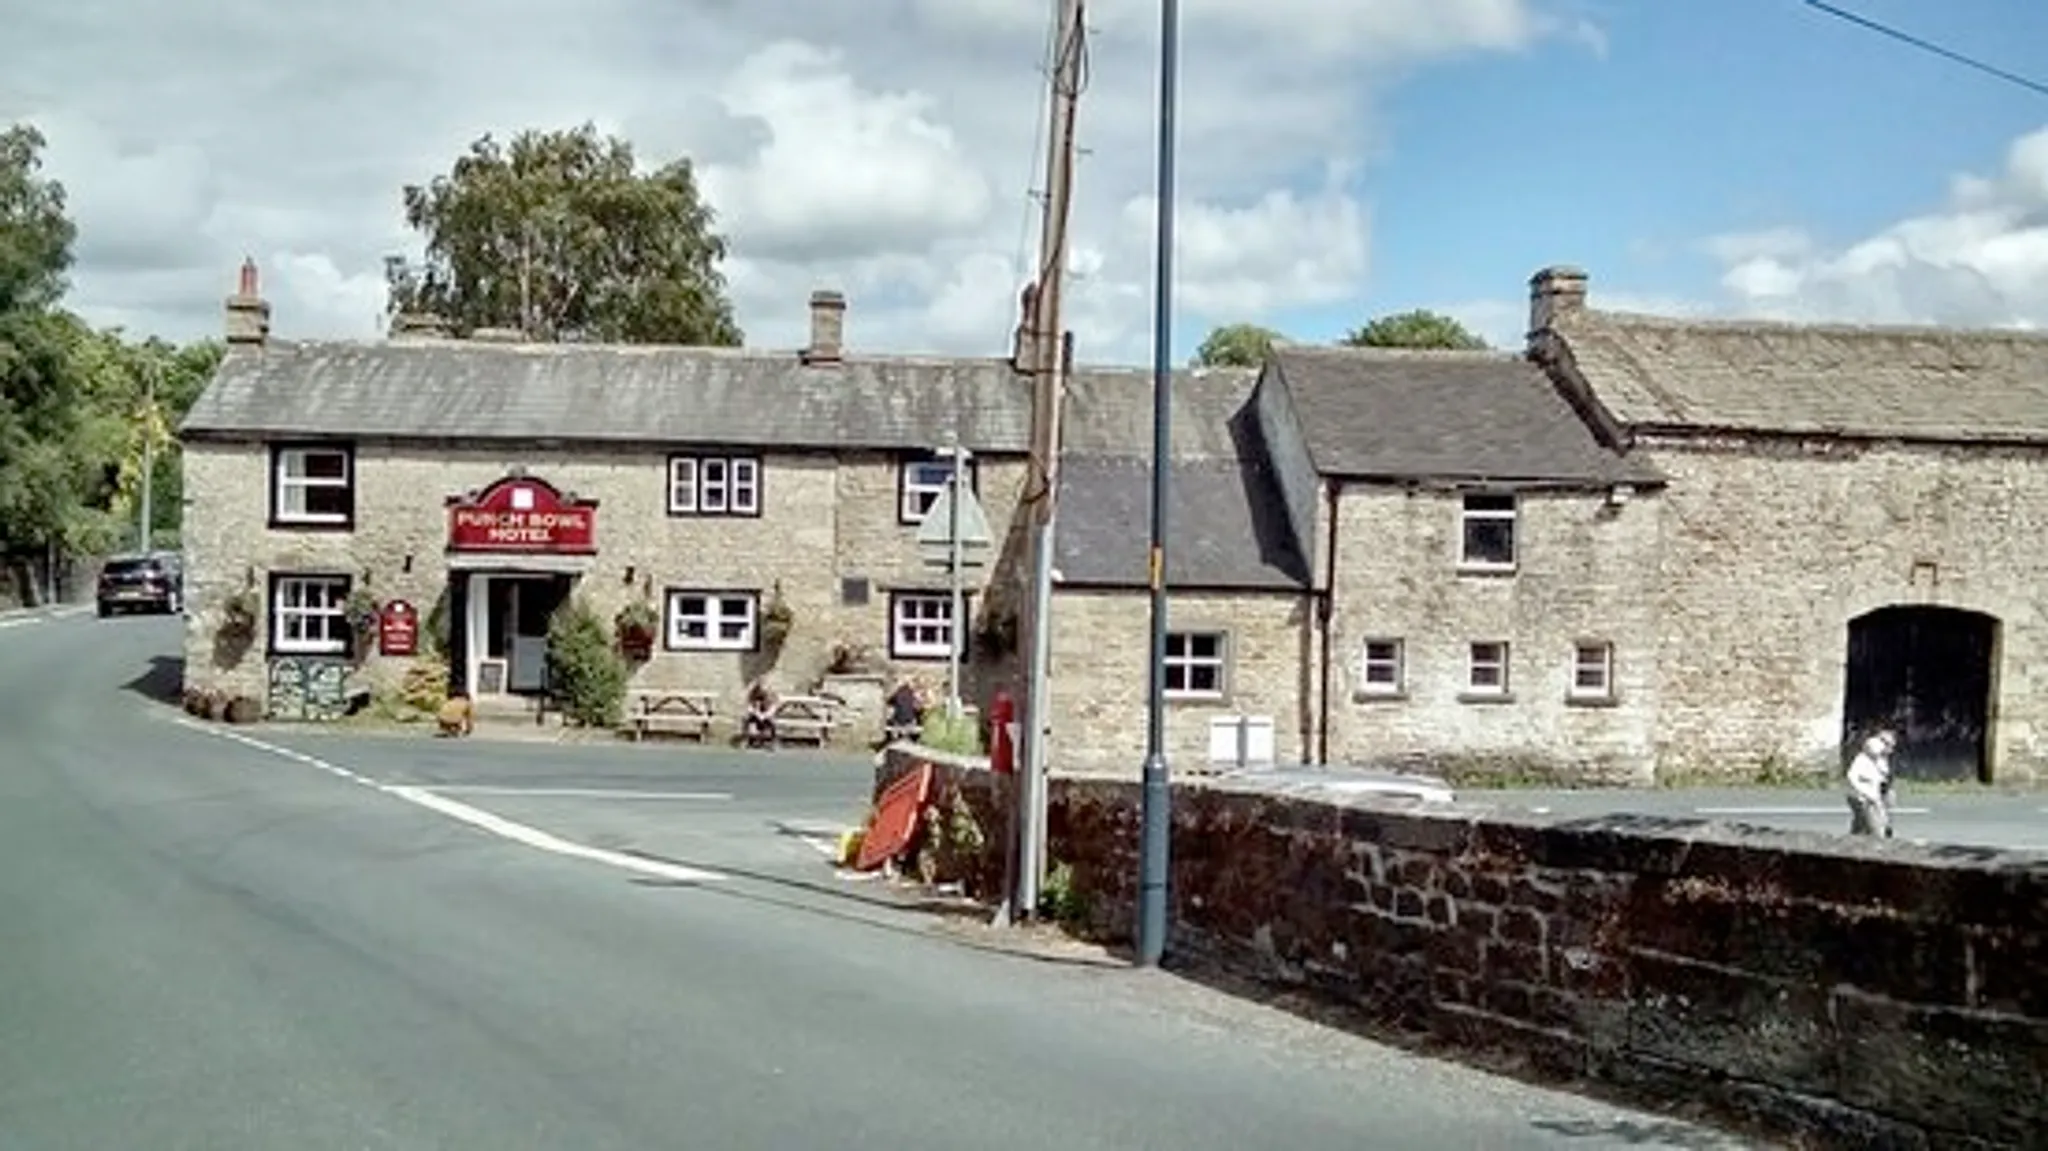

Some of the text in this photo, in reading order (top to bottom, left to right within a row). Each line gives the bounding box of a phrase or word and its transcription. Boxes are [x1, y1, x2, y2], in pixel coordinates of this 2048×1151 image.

[457, 512, 585, 529] PUNCH BOWL
[488, 528, 552, 541] HOTEL
